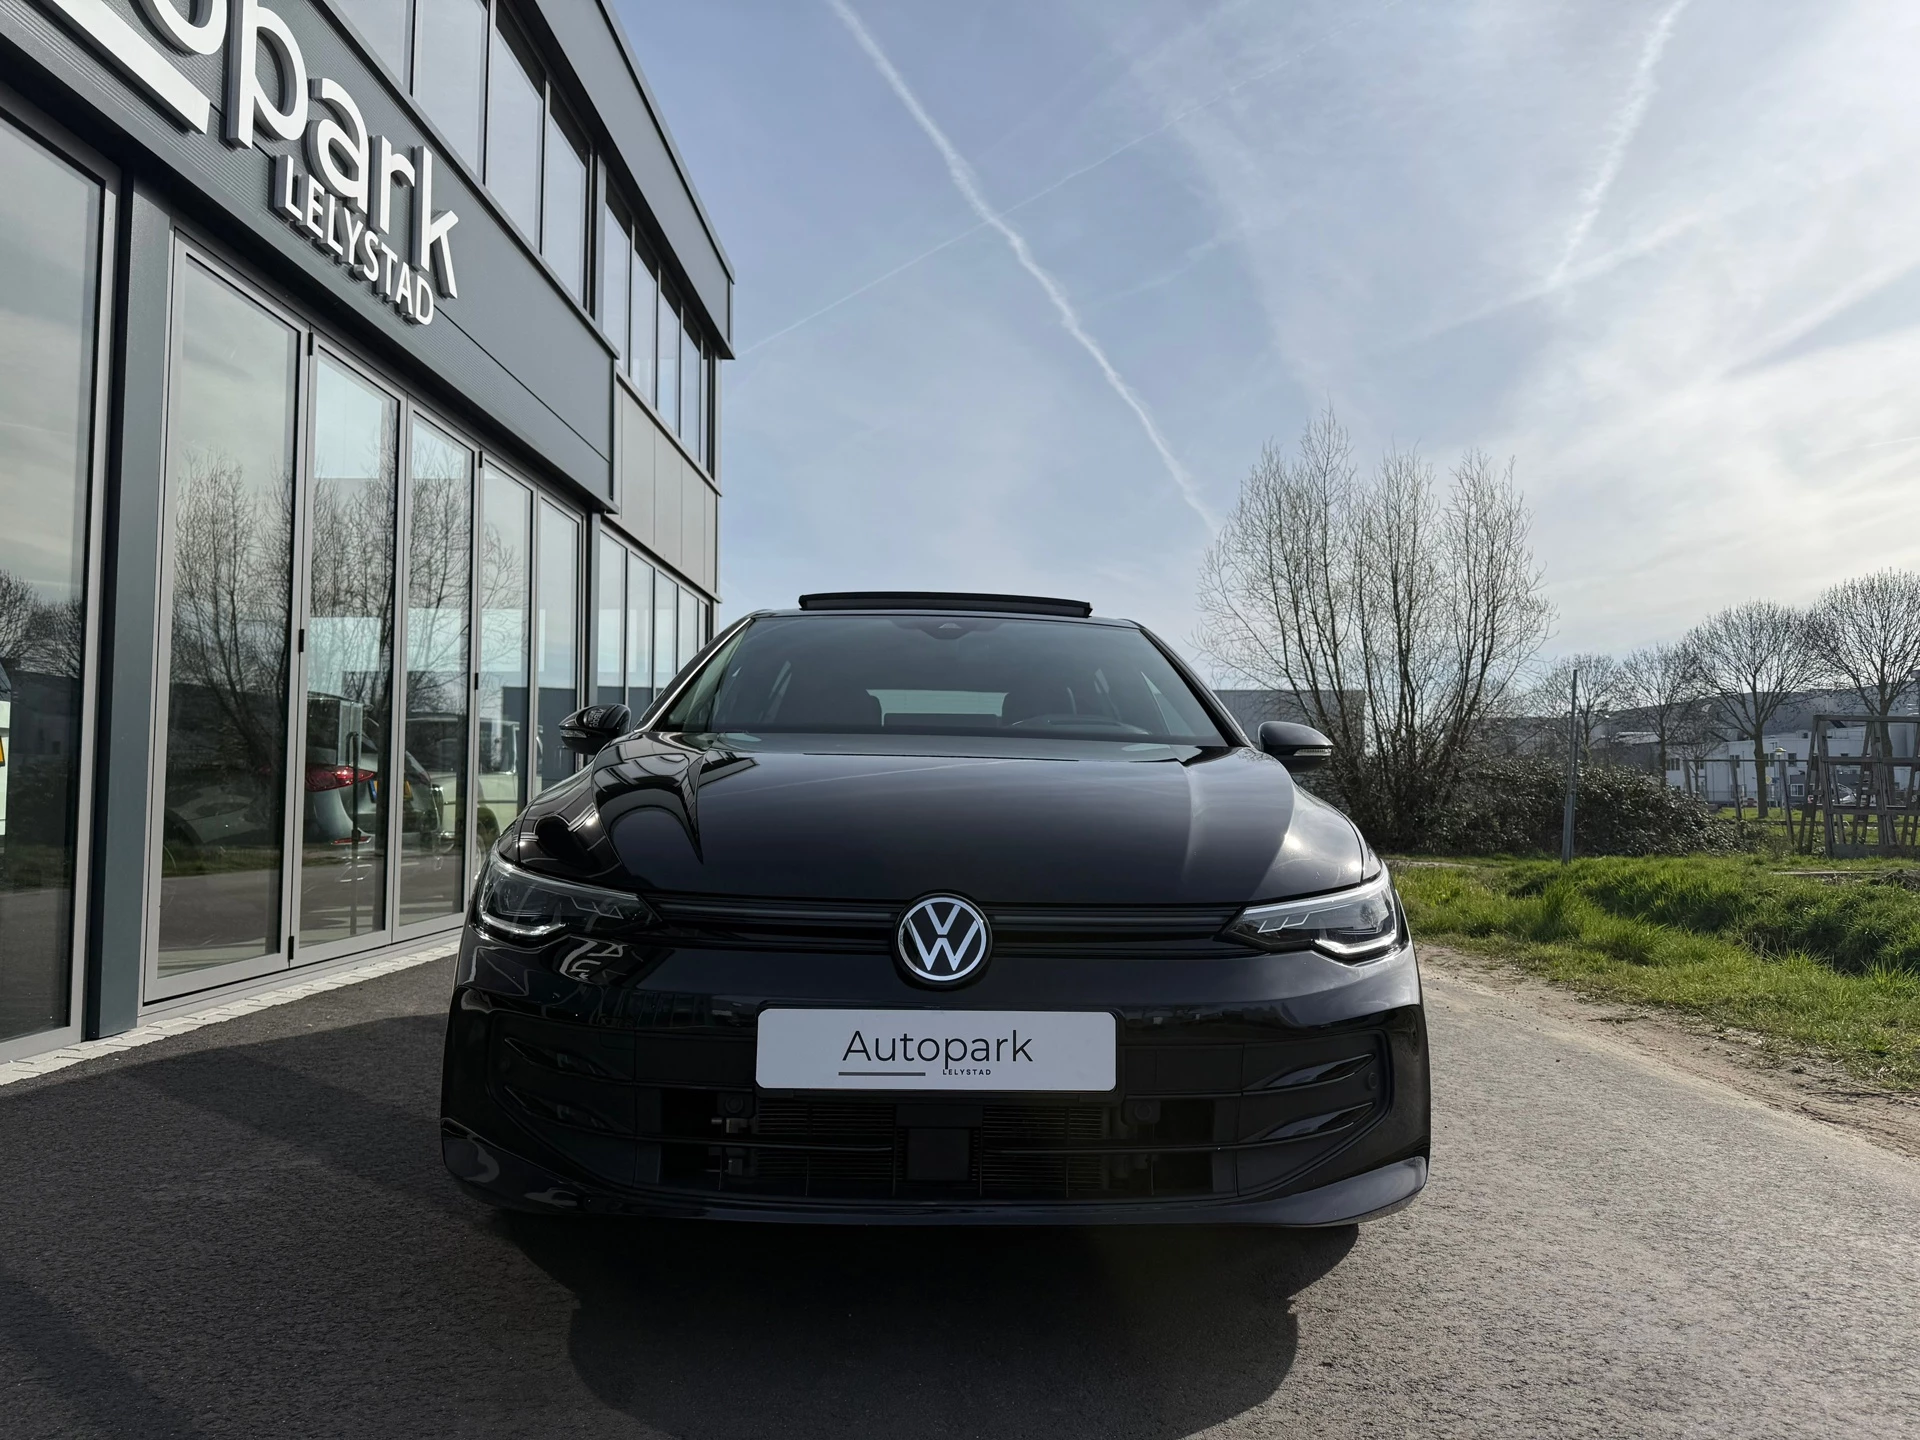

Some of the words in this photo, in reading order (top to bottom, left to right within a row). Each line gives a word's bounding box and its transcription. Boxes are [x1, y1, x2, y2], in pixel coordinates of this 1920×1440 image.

[278, 154, 435, 326] LELYSTAD
[842, 1029, 1034, 1070] Autopark
[942, 1068, 992, 1076] LELYSTAD
